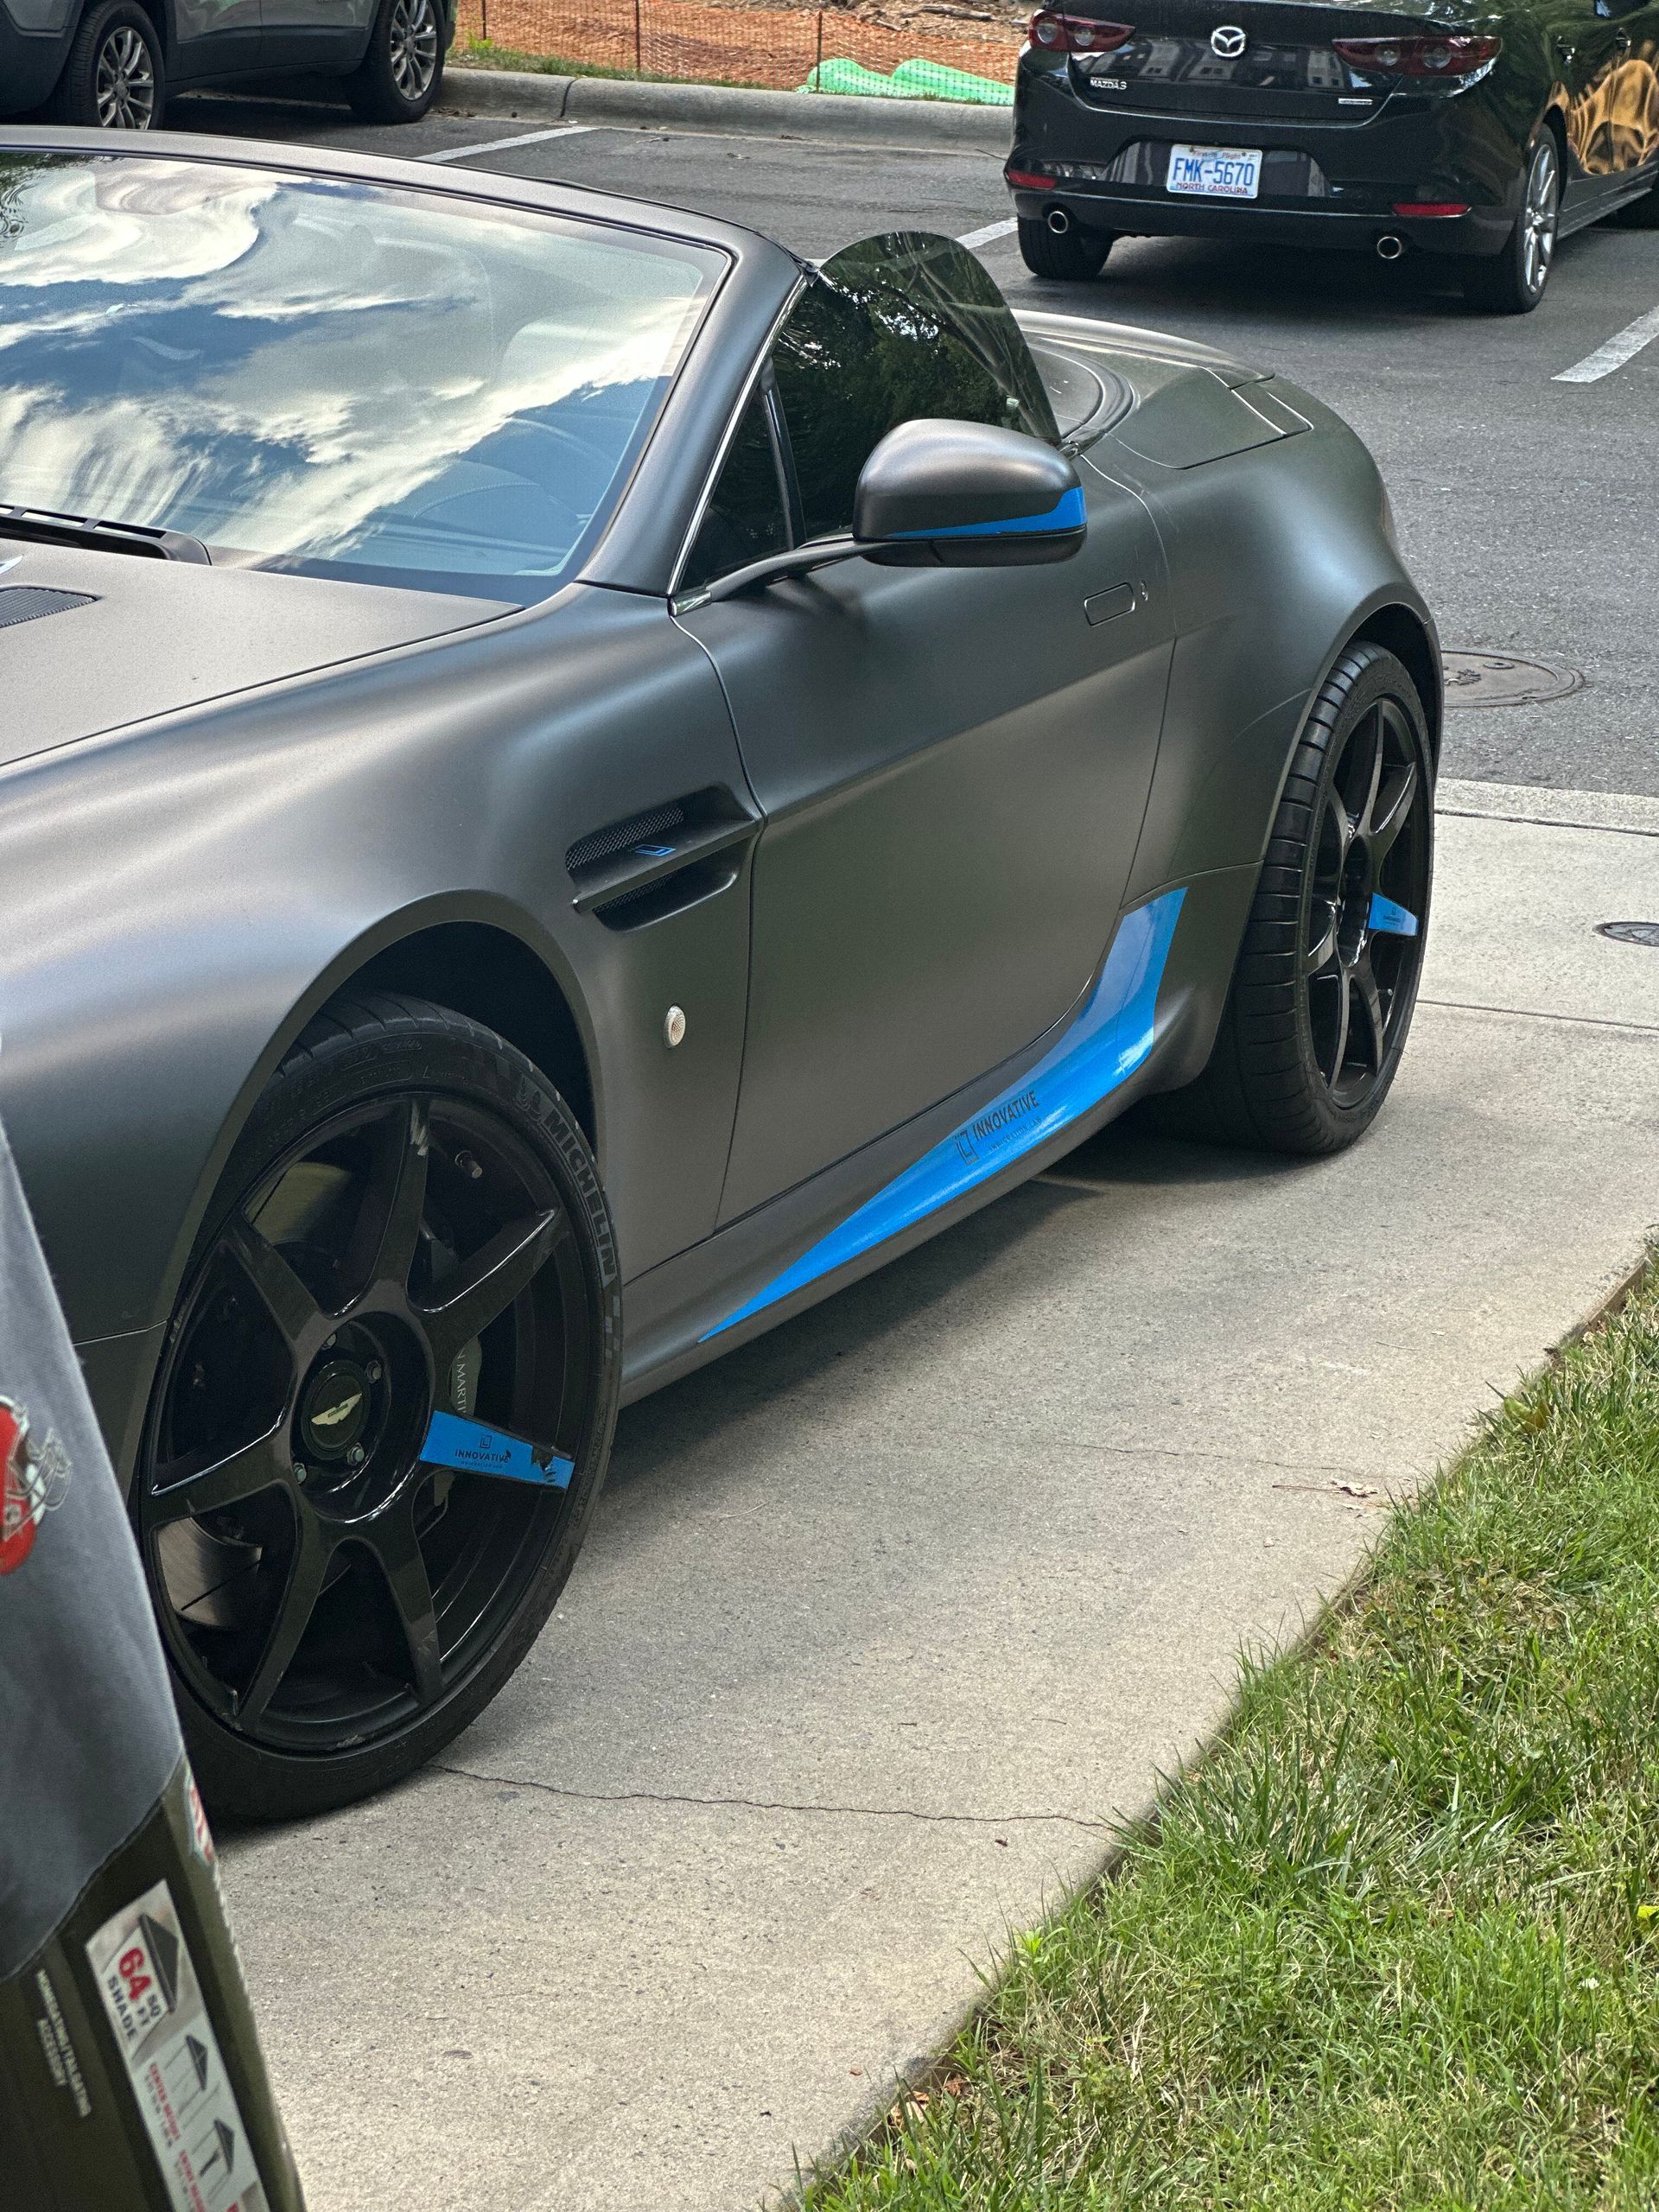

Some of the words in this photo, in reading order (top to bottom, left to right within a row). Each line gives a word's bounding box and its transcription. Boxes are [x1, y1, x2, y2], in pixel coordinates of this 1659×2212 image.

[1173, 157, 1255, 187] FMK-5670
[1176, 181, 1205, 191] NORTH
[1207, 184, 1248, 194] CAROLINA
[973, 1090, 1039, 1141] INNOVATIVE
[543, 1107, 617, 1277] MICHELIN
[118, 1947, 152, 2002] 64
[107, 1975, 137, 2038] SHADE
